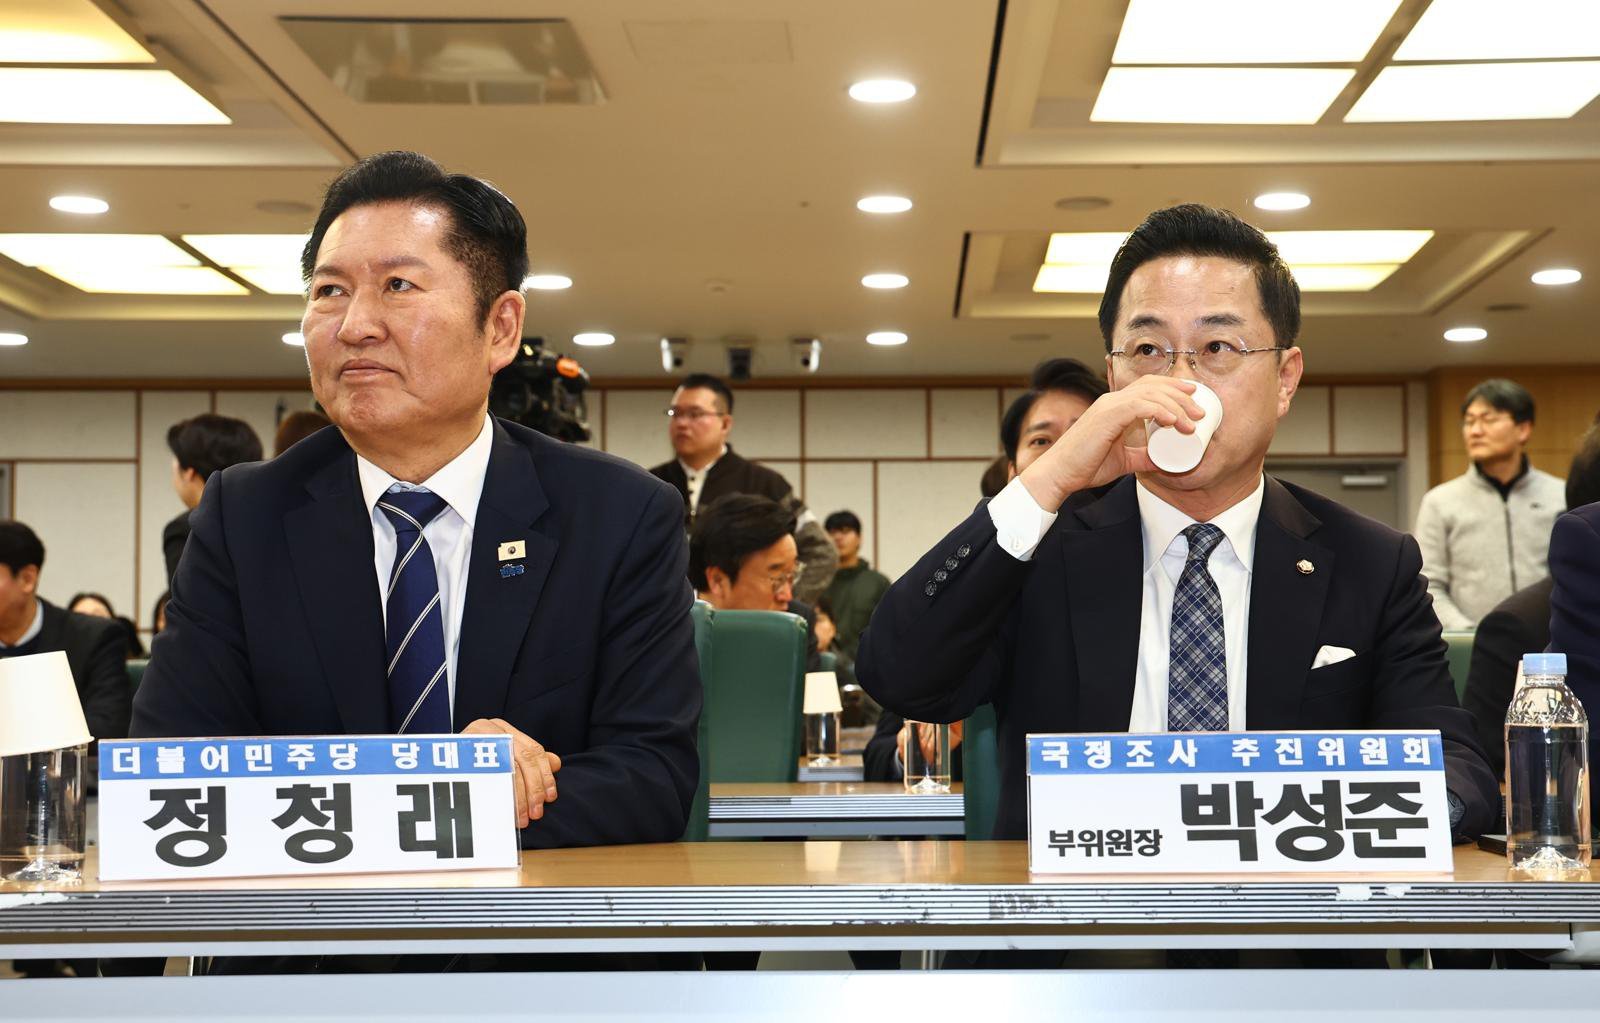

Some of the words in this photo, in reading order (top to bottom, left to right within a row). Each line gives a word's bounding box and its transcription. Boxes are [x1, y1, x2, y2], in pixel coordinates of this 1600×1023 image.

[112, 743, 358, 774] 더불어민주당
[392, 741, 500, 769] 당대표
[1041, 739, 1198, 769] 국정조사
[1231, 737, 1431, 767] 추진위원회
[143, 781, 475, 868] 정청래
[1047, 829, 1163, 858] 부위원장
[1180, 779, 1429, 862] 박성준
